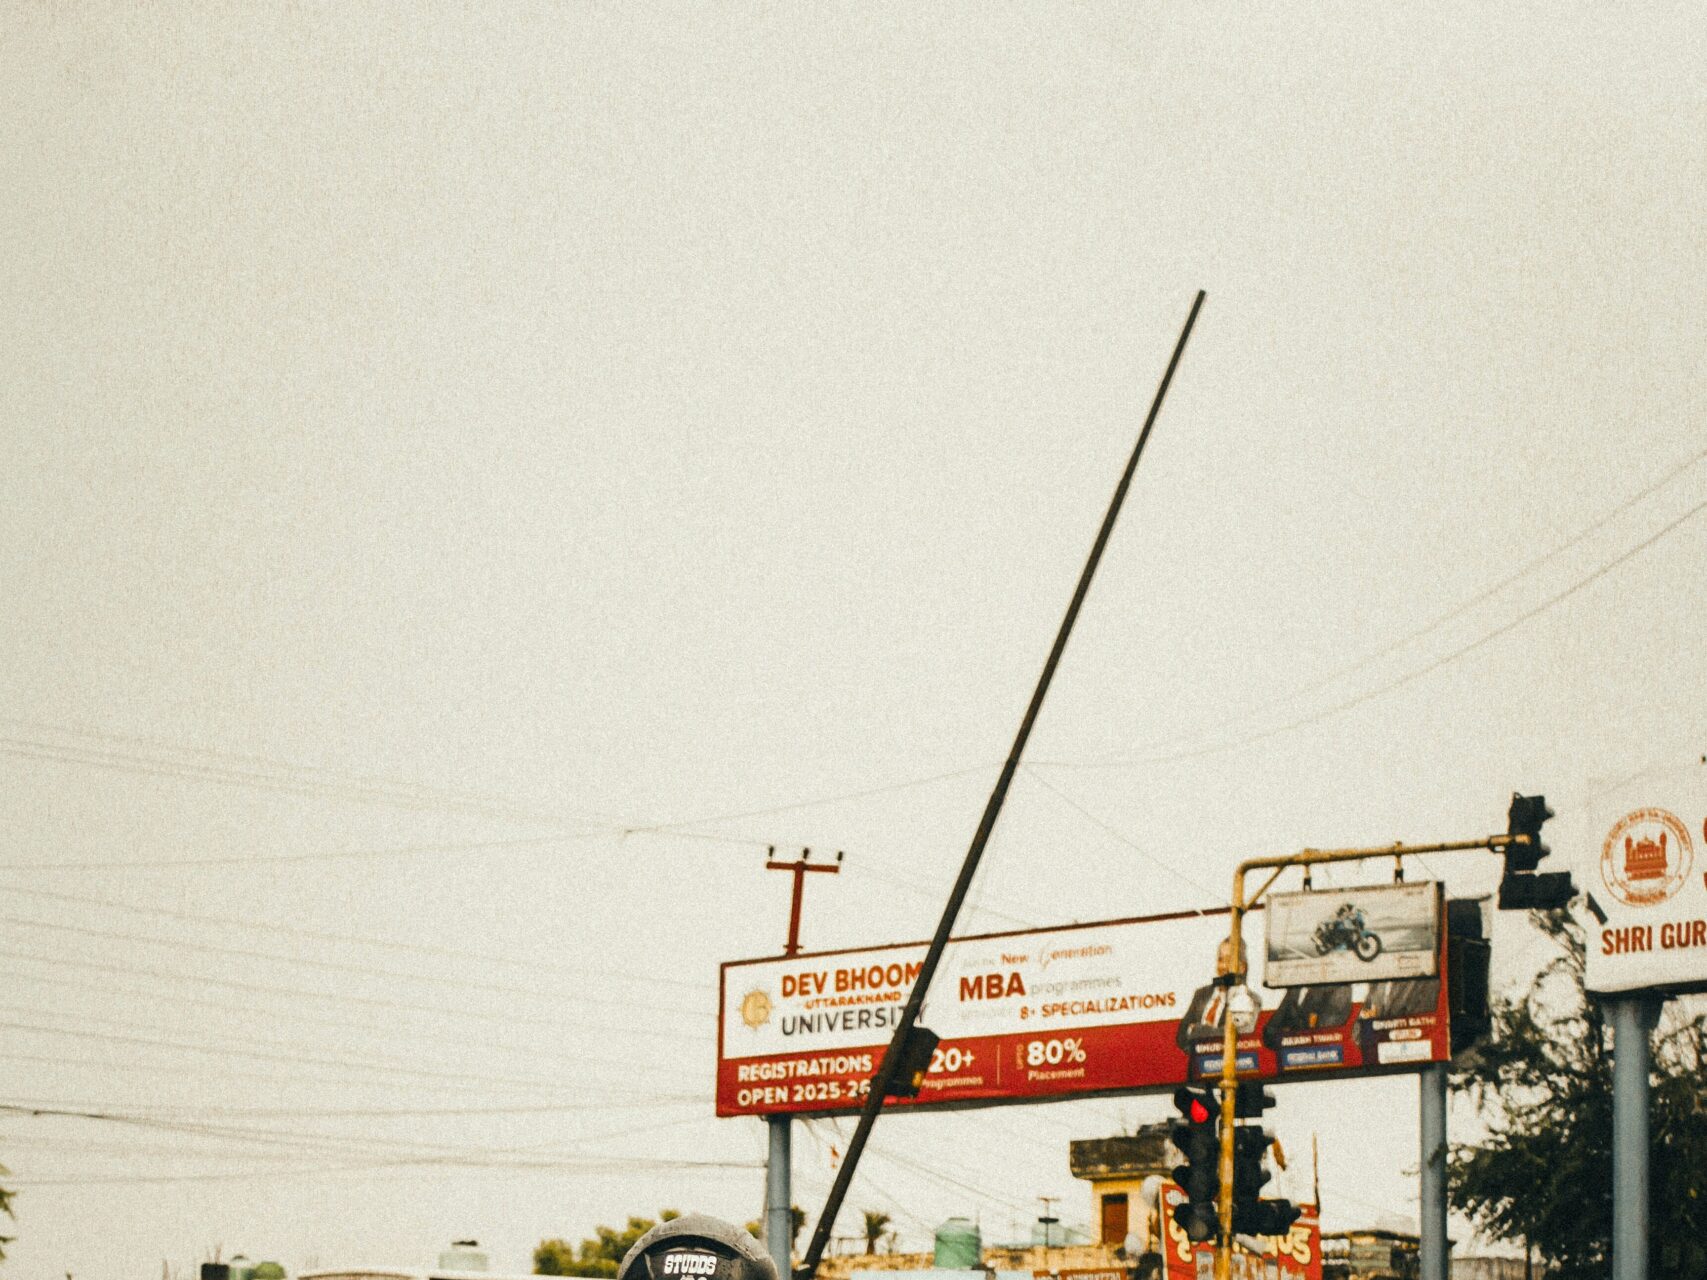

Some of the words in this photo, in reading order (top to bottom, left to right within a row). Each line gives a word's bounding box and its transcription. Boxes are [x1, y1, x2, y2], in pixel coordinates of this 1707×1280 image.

[1602, 926, 1652, 955] SHRI
[782, 972, 827, 997] DEV
[835, 961, 924, 992] BHOOM
[960, 972, 1025, 1002] MBA
[805, 991, 902, 1009] UTTARAKHAND
[1042, 992, 1176, 1017] SPECIALIZATIONS
[1027, 1037, 1086, 1066] 80%
[738, 1054, 873, 1082] REGISTRATIONS
[1028, 1067, 1085, 1081] Placement
[737, 1086, 788, 1106] OPEN
[664, 1254, 717, 1275] STUDDS
